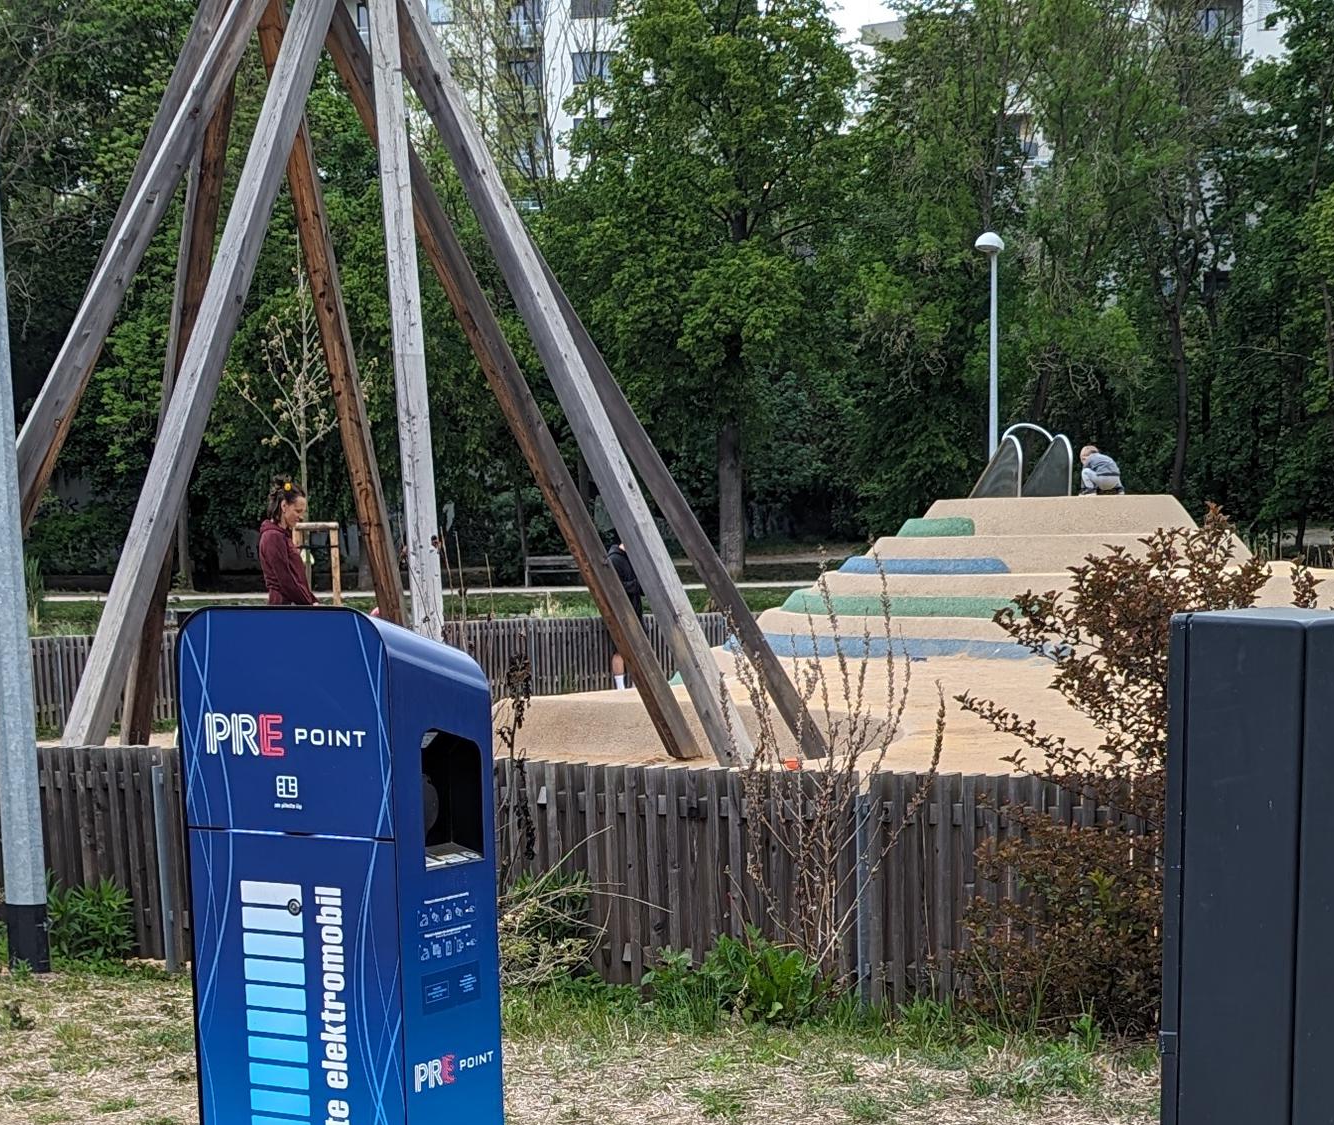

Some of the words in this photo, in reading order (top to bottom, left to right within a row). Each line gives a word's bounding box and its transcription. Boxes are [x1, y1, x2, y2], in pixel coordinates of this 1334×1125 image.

[205, 712, 284, 756] PRE
[294, 728, 366, 747] POINT
[314, 886, 349, 1090] elektromobil
[414, 1054, 455, 1093] PRE
[459, 1050, 494, 1071] POINT
